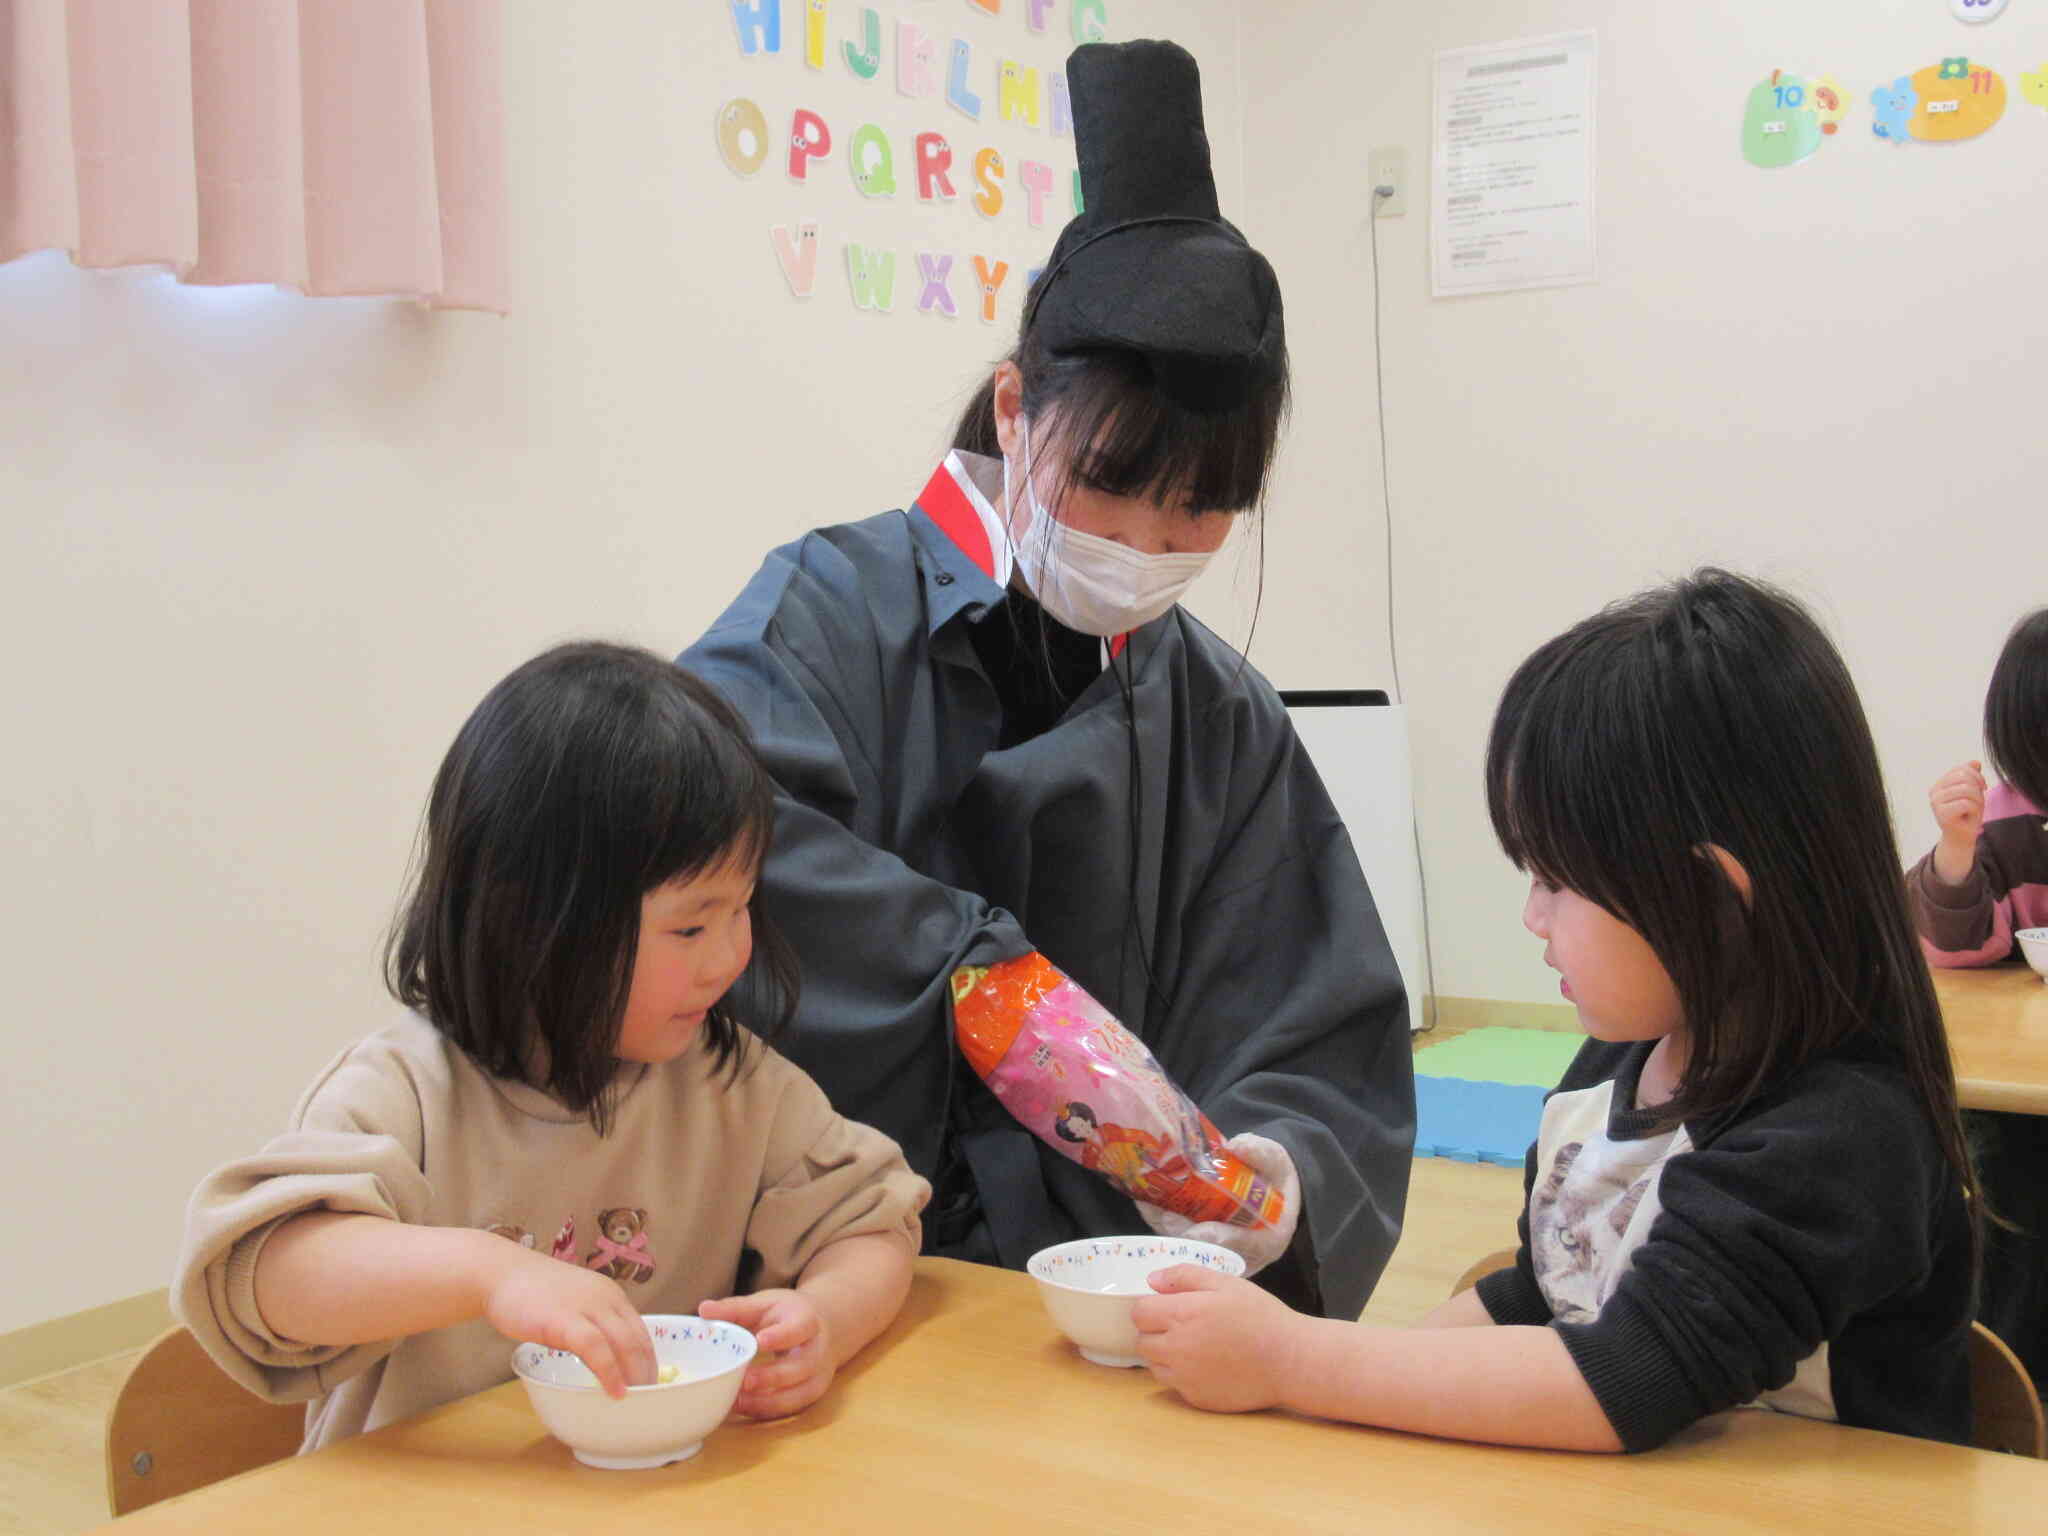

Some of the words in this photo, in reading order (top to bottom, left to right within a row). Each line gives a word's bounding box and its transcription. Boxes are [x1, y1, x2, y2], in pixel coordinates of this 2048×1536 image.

[729, 0, 781, 55] H
[842, 8, 882, 80] J
[899, 20, 937, 98] K
[945, 37, 983, 121] L
[998, 59, 1042, 128] M
[1773, 85, 1805, 109] 10
[1970, 71, 1994, 96] 11
[716, 97, 769, 176] O
[786, 108, 832, 181] P
[851, 122, 897, 198] Q
[915, 131, 957, 200] R
[973, 146, 1005, 217] S
[1021, 160, 1054, 227] T
[770, 223, 819, 298] V
[846, 242, 897, 312] W
[917, 252, 957, 315] X
[971, 254, 1009, 322] Y
